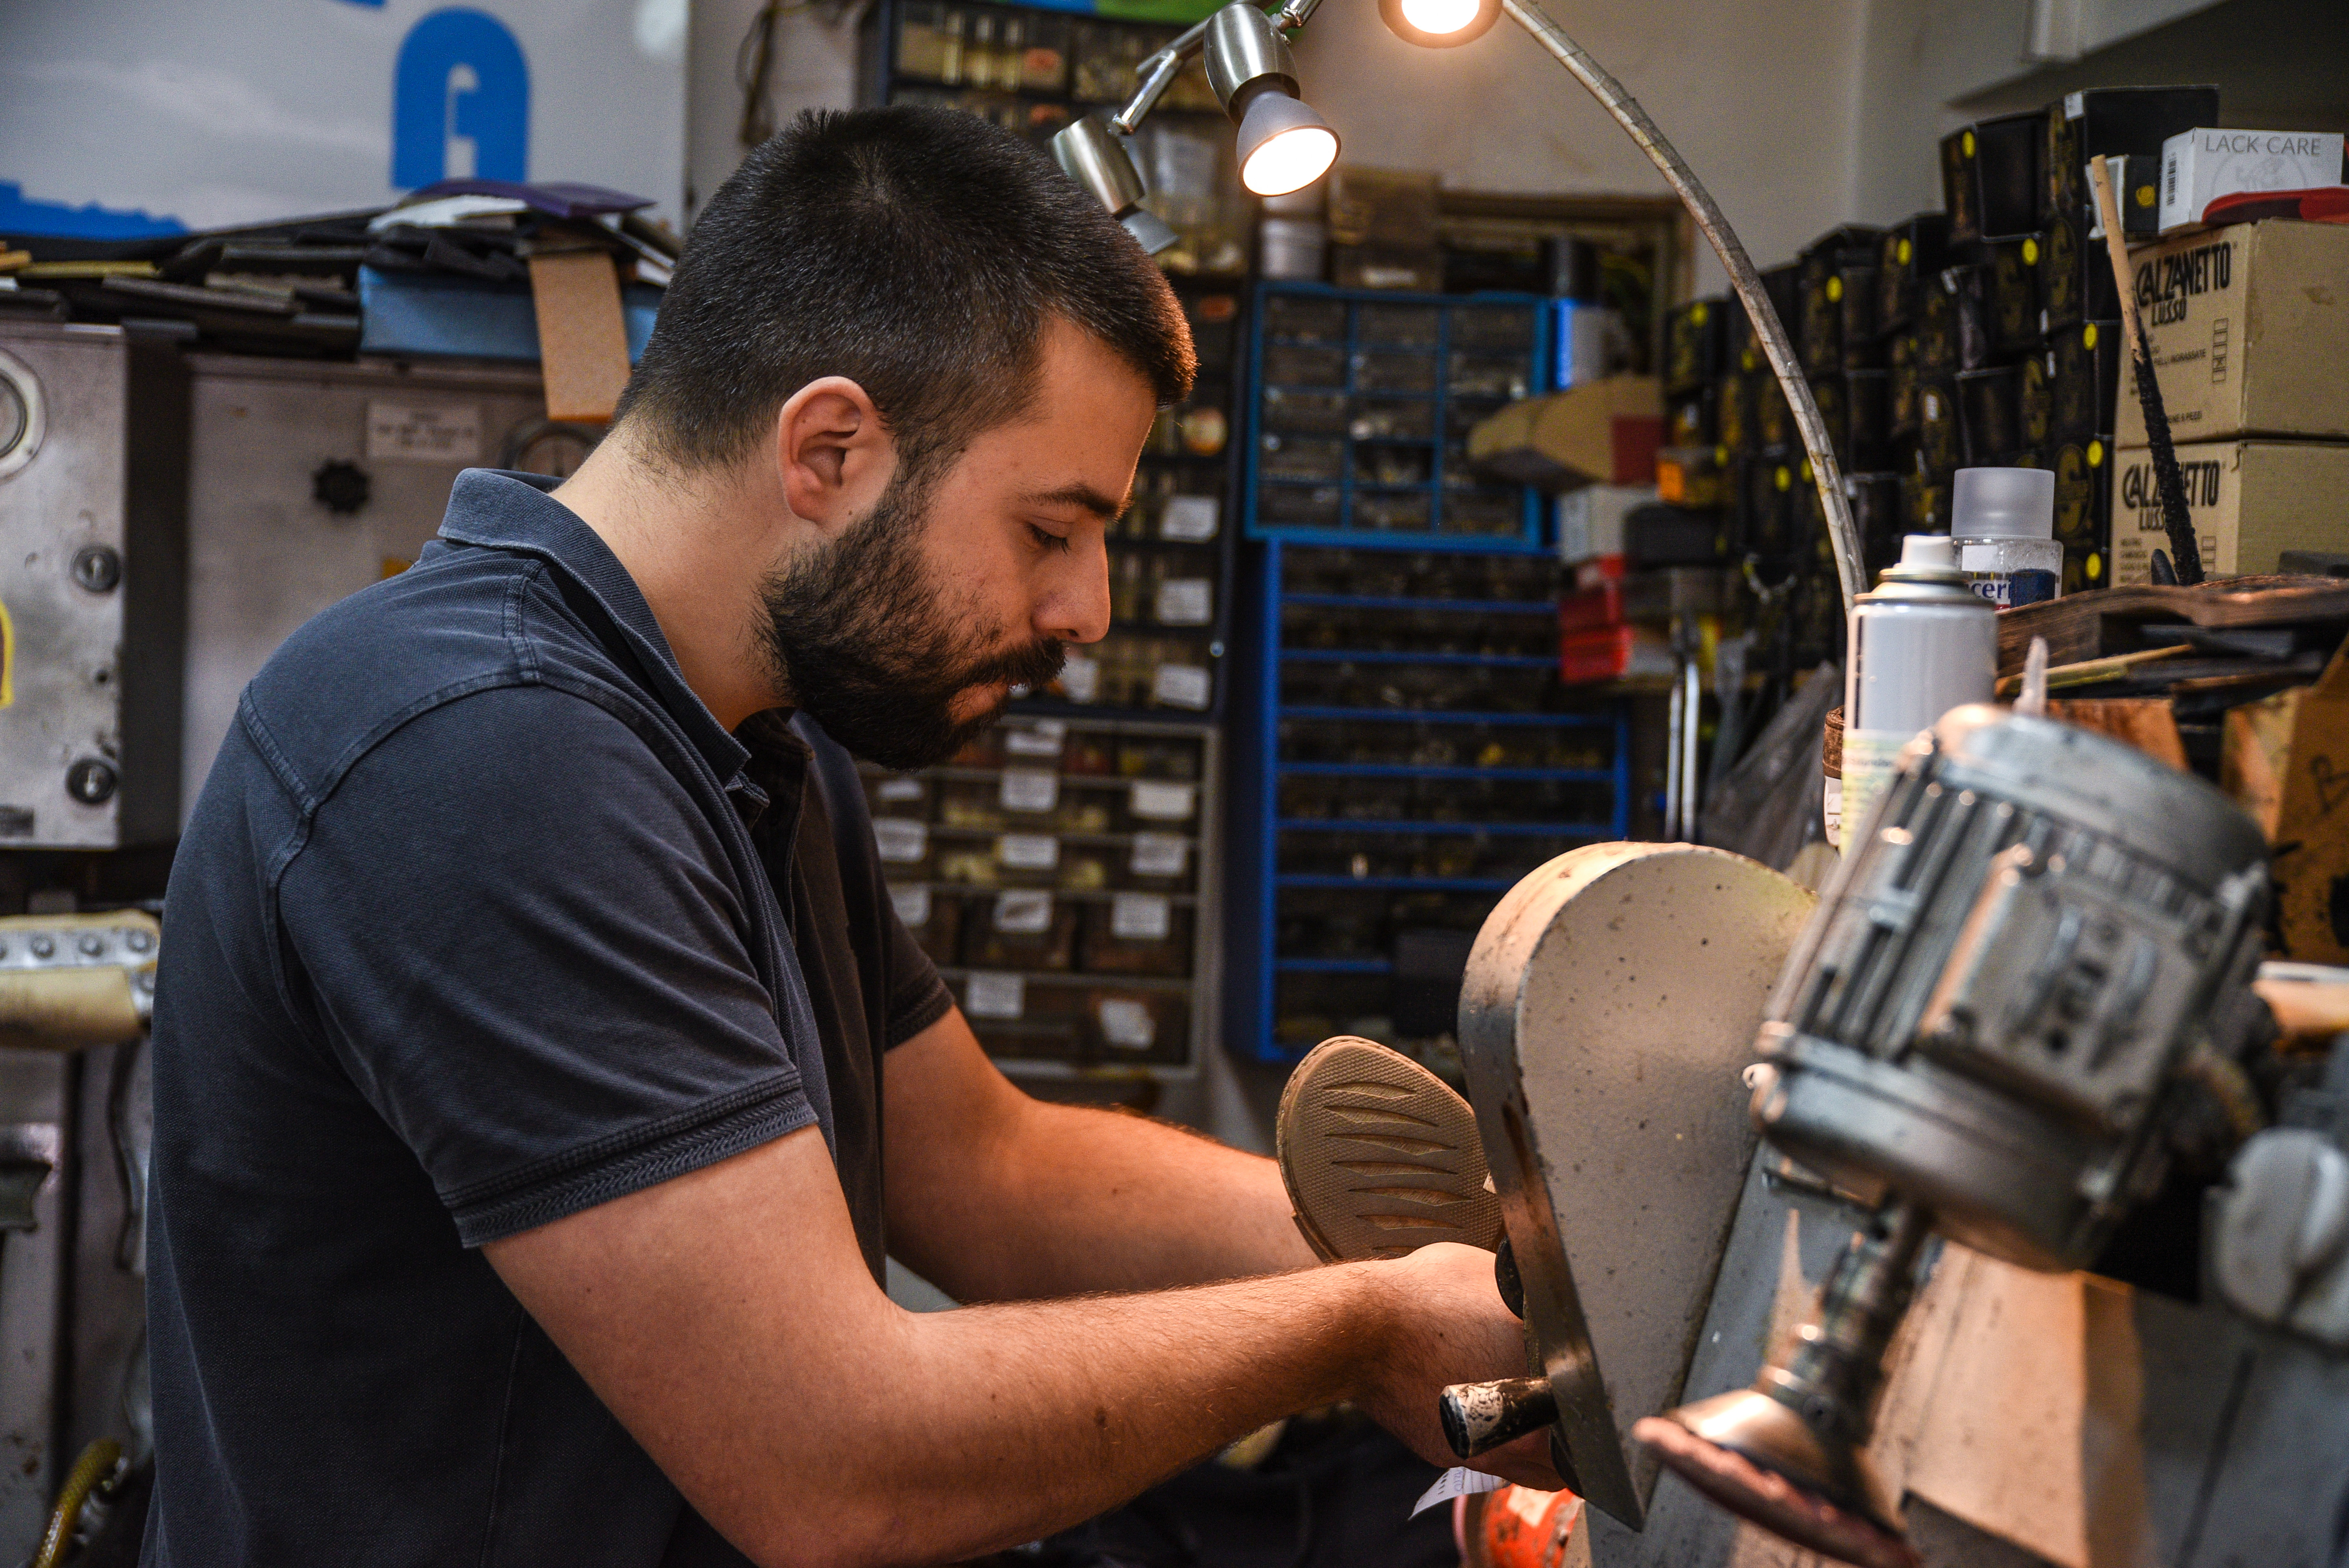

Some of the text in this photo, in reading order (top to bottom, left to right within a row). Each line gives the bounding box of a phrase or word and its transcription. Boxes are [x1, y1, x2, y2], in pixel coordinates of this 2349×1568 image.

[2206, 135, 2322, 156] LACK CARE
[2136, 241, 2231, 306] CALZANETTO
[2151, 297, 2187, 326] LUSSO
[2122, 460, 2220, 509] CALZETTO
[2139, 508, 2166, 531] LUSS
